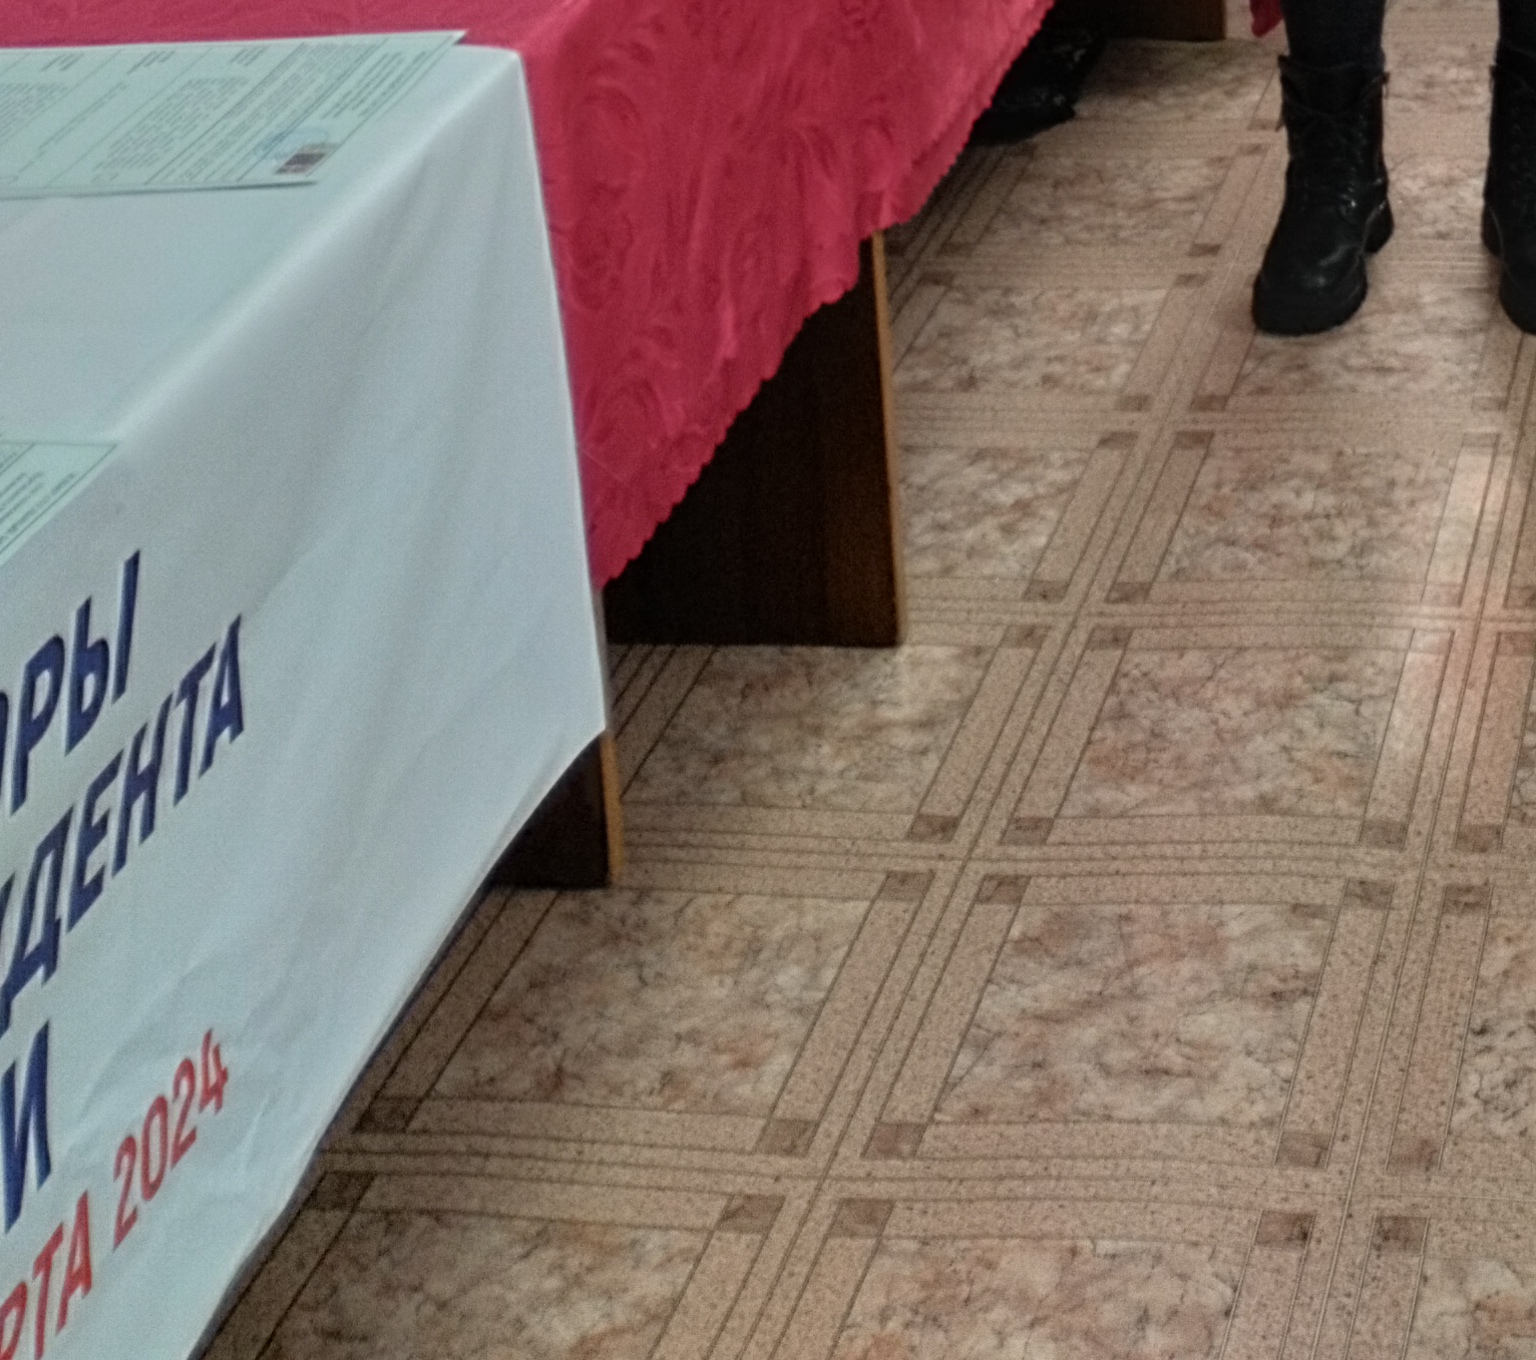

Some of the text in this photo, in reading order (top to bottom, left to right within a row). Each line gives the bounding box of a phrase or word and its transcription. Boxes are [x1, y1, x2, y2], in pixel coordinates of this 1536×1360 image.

[0, 548, 141, 817] РЫ
[0, 611, 245, 1041] ДЕНТА
[111, 1026, 229, 1255] 2024
